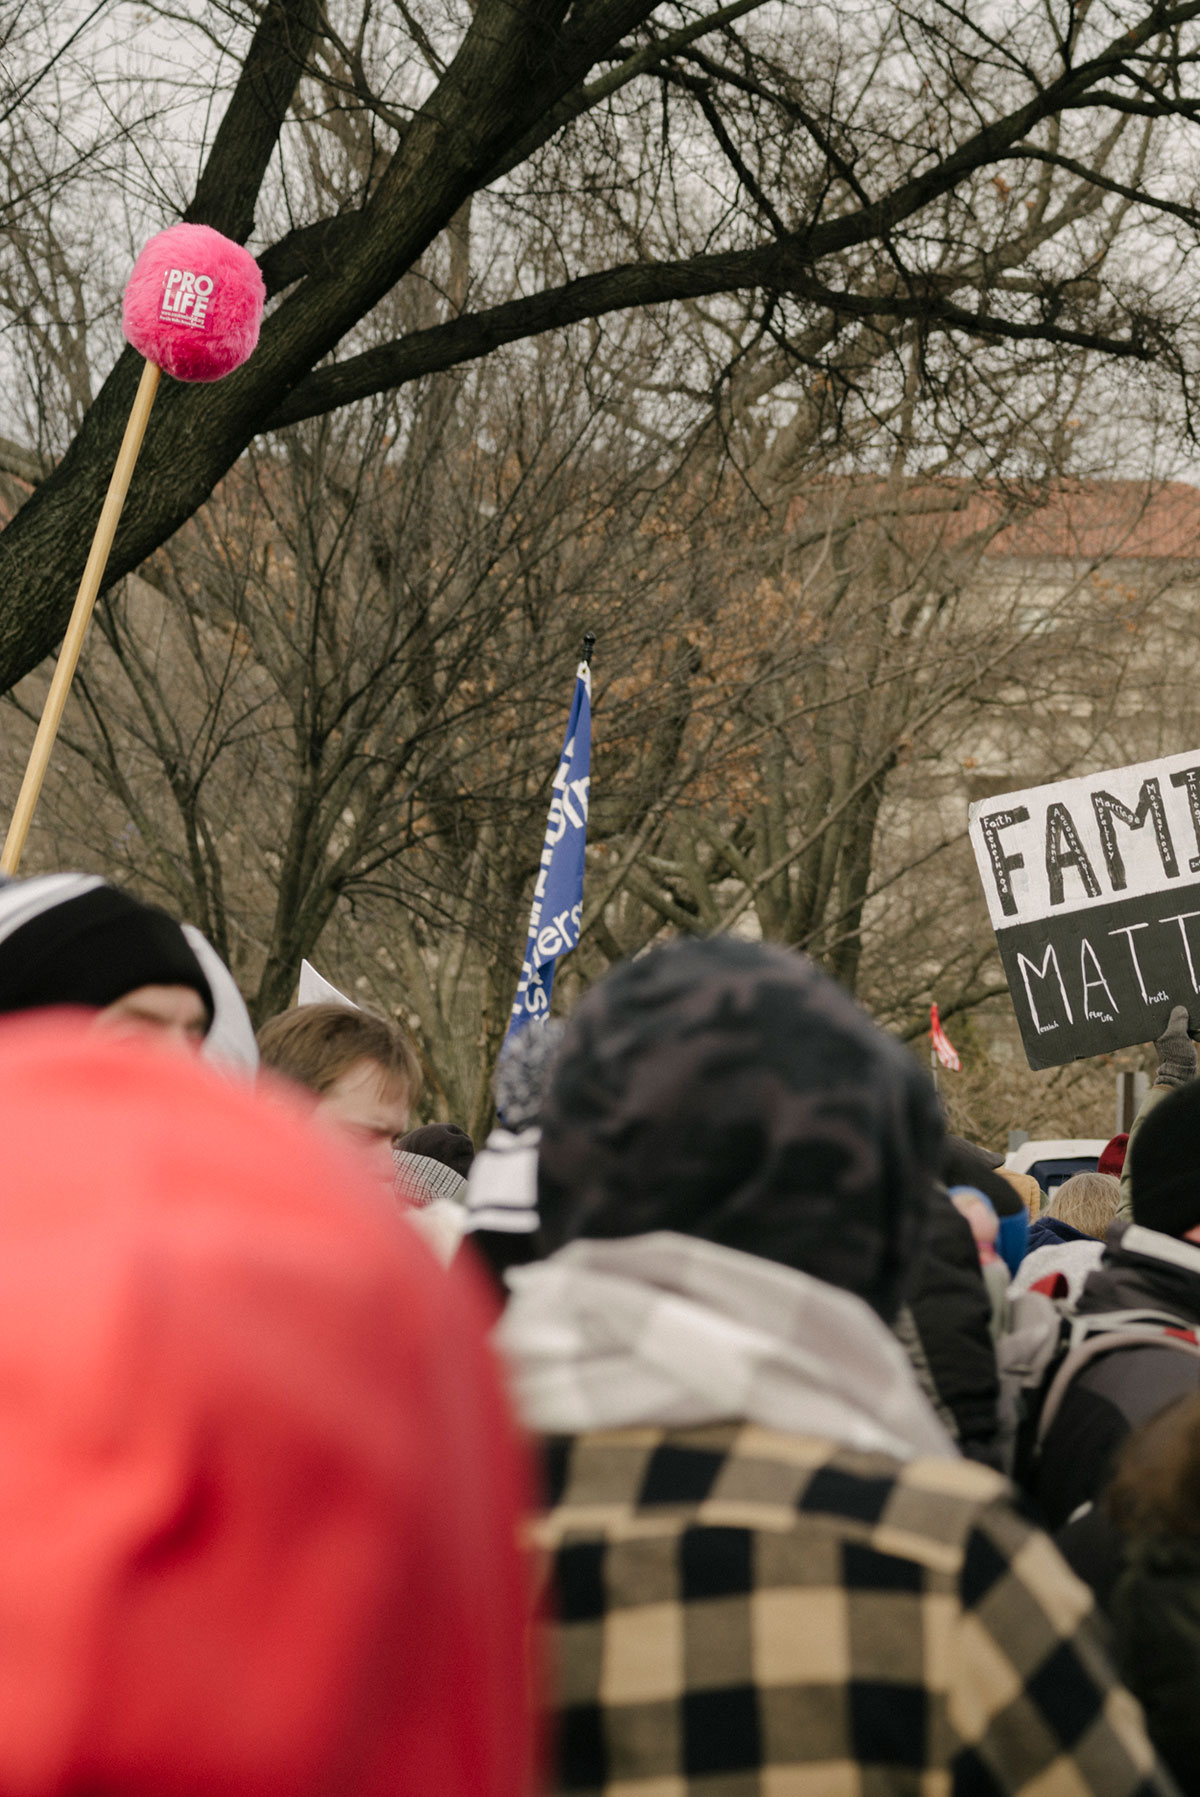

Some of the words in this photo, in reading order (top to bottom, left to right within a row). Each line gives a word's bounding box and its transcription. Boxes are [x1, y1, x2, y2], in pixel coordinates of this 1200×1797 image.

[167, 269, 213, 297] PRO
[162, 289, 209, 318] LIFE
[983, 813, 1013, 829] Faith
[1145, 782, 1171, 862] Motherhood
